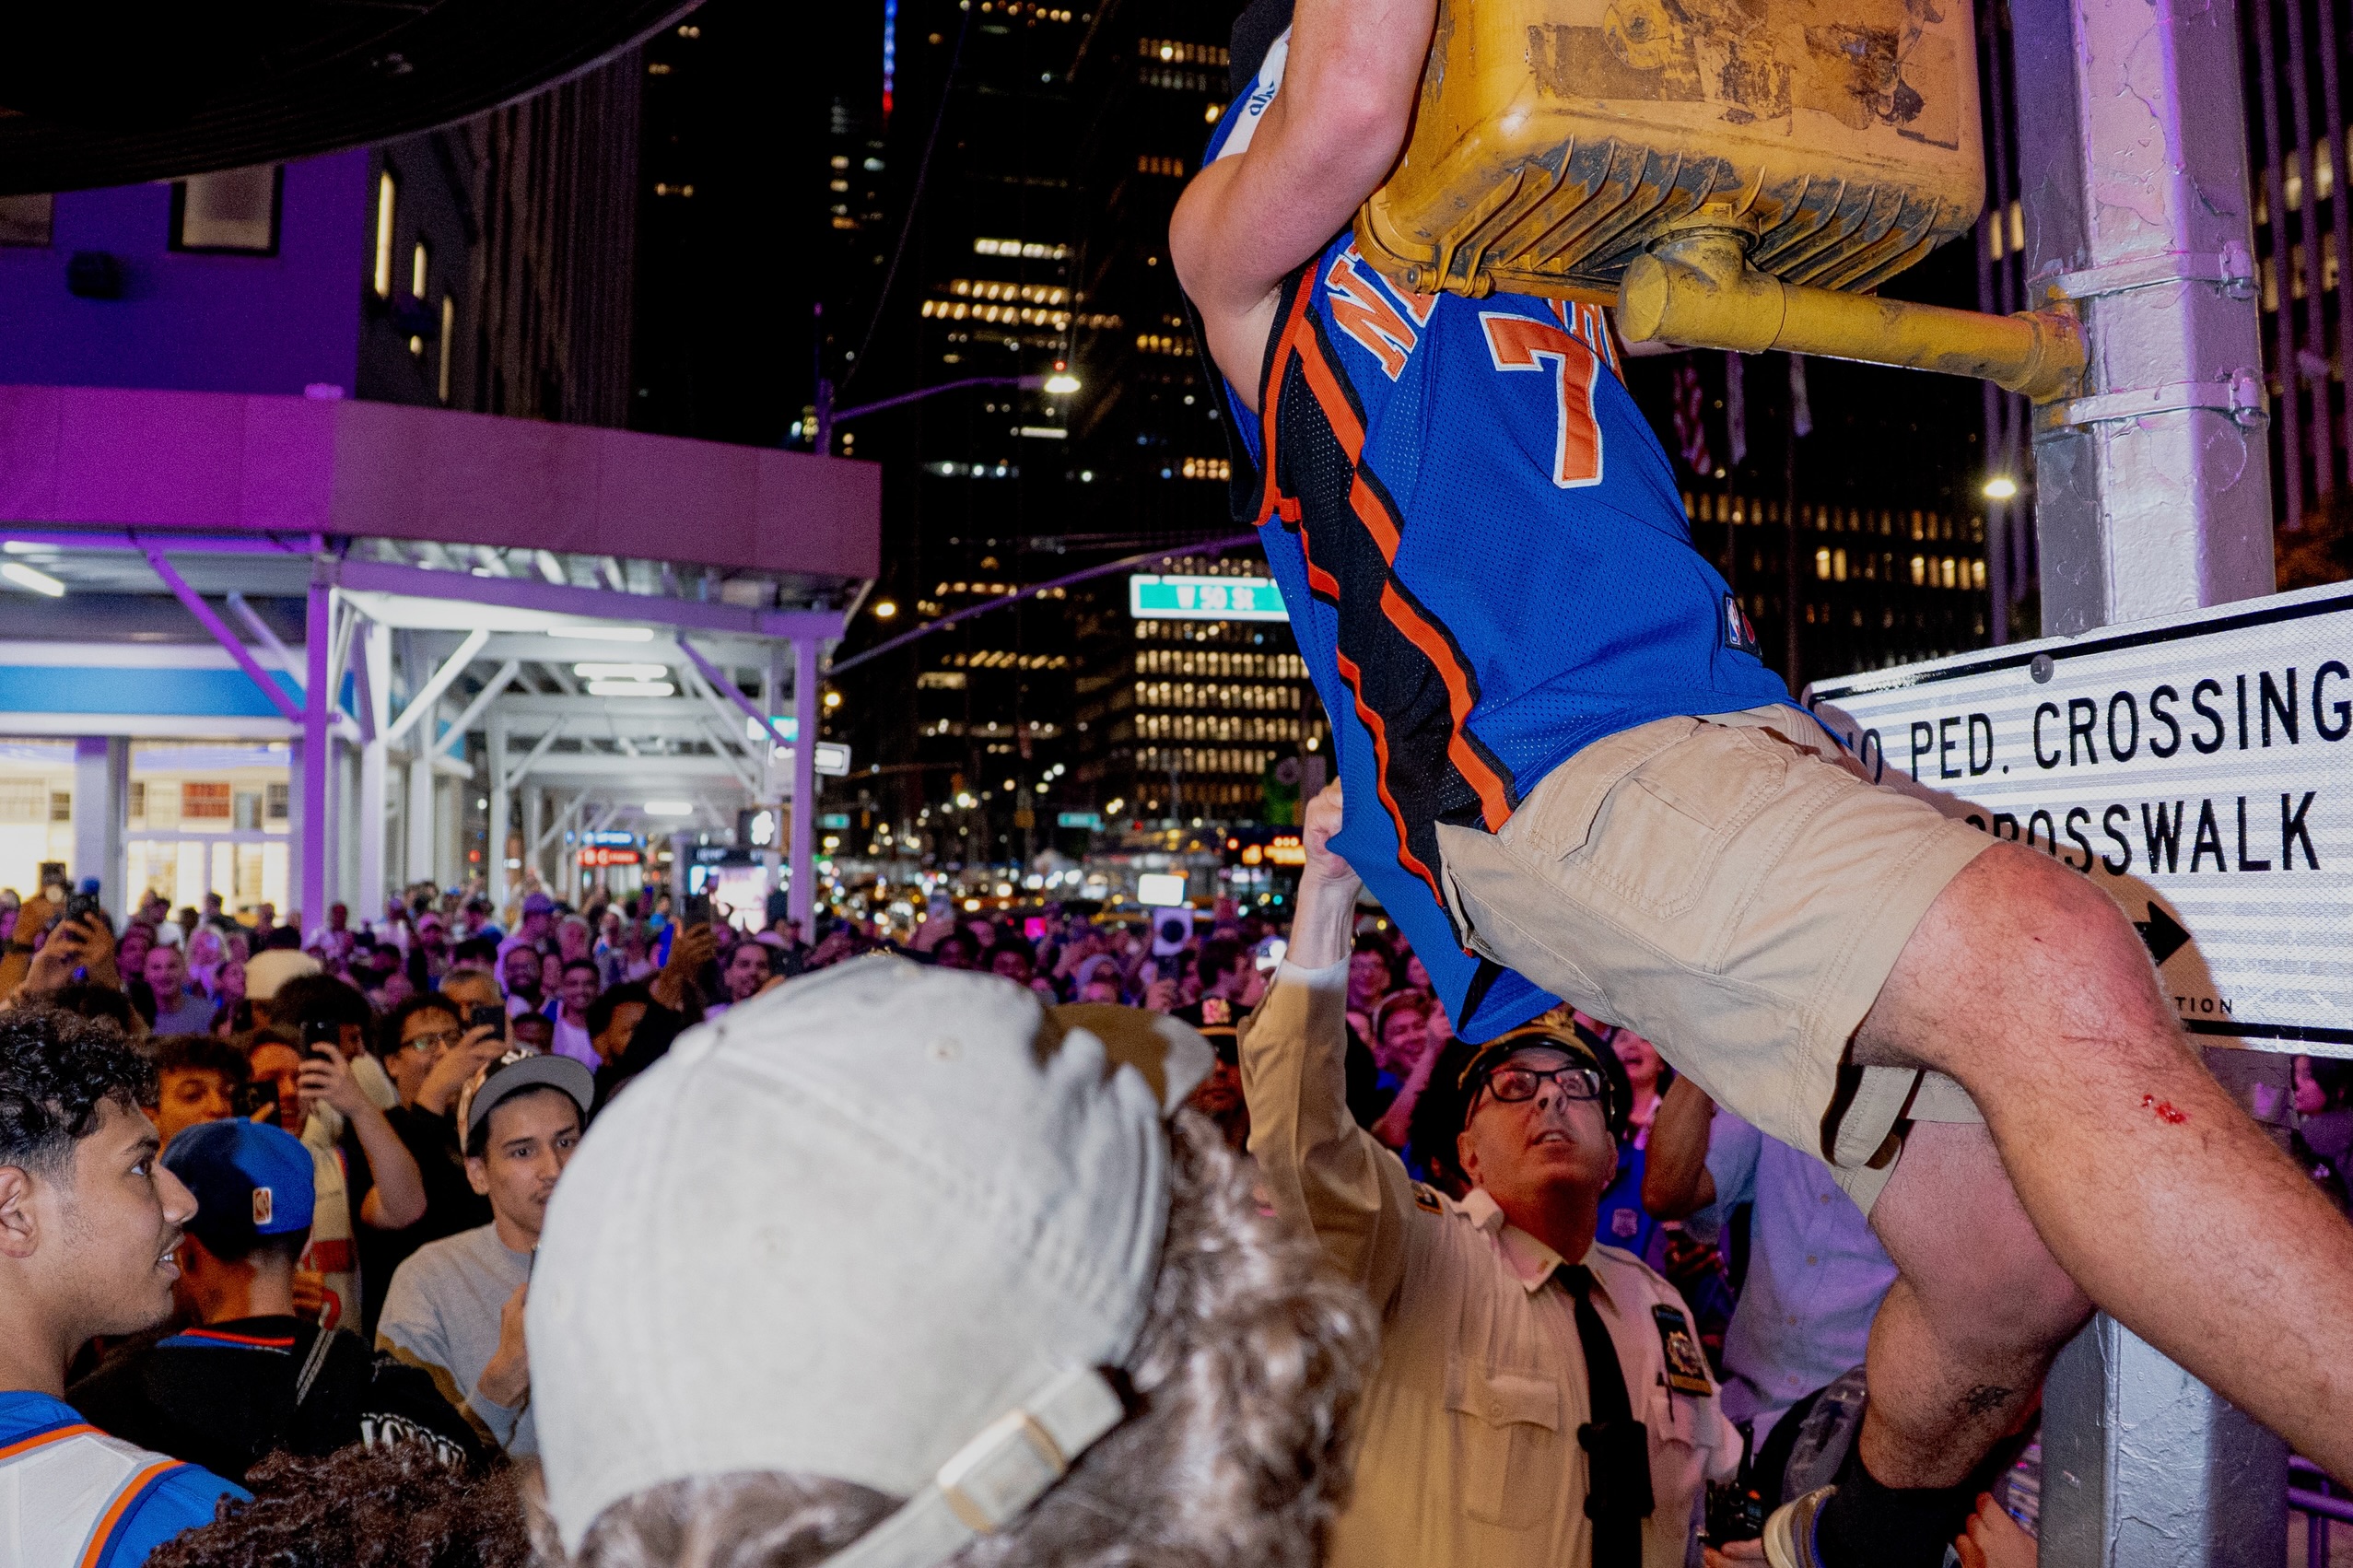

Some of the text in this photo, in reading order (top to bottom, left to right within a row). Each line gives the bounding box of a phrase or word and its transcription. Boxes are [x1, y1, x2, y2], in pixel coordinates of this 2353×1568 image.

[1479, 311, 1603, 488] 7
[1176, 585, 1196, 609] W
[1200, 585, 1228, 610] 50
[1847, 660, 2352, 785] O PED. CROSSING
